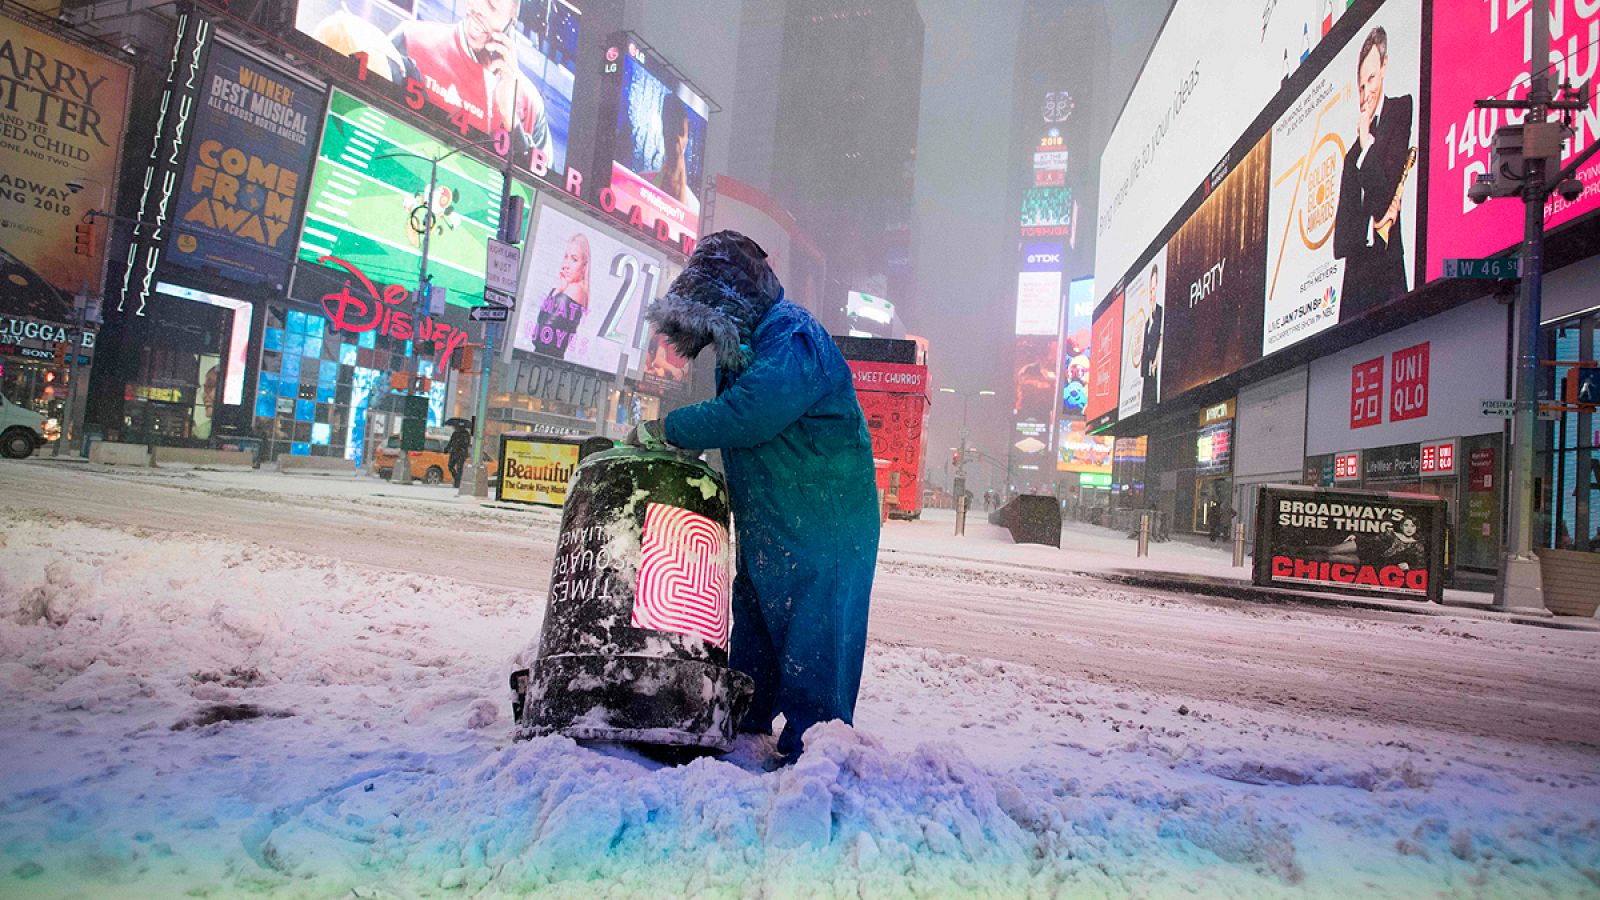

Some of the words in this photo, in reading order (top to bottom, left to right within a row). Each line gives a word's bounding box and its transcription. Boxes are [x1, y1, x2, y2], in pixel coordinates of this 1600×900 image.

[239, 66, 295, 108] WINNER!
[0, 74, 110, 147] TTER
[212, 75, 249, 107] BEST
[251, 92, 308, 136] MUSICAL
[1150, 107, 1172, 164] your
[1173, 59, 1200, 121] ideas
[27, 121, 48, 135] THE
[208, 95, 222, 110] ALL
[223, 102, 253, 123] ACROSS
[255, 115, 277, 133] NORTH
[277, 126, 306, 146] AMERICA
[1445, 95, 1498, 170] 140
[0, 141, 20, 153] ONE
[24, 148, 45, 160] AND
[47, 155, 69, 167] TWO
[33, 134, 90, 162] CHILD
[200, 139, 299, 198] COME
[1308, 152, 1337, 192] GOLDEN
[0, 174, 70, 201] ADWAY
[192, 164, 294, 224] FROM
[34, 196, 71, 216] 2018
[1307, 198, 1335, 233] AWARDS
[184, 197, 289, 247] AWAY
[1300, 278, 1314, 293] SETH
[1314, 264, 1338, 284] MEYERS
[1460, 261, 1474, 276] W
[1481, 260, 1501, 276] 46
[1507, 260, 1517, 271] St
[1189, 257, 1227, 309] PARTY
[597, 252, 662, 350] 21
[1322, 304, 1336, 318] NBC
[0, 316, 97, 348] LUGGAE
[1267, 317, 1281, 333] LIVE
[22, 347, 55, 359] SONY
[1395, 352, 1422, 383] UNI
[514, 361, 602, 408] FOREVER
[858, 370, 883, 382] SWEET
[884, 372, 921, 385] CHURROS
[1356, 366, 1379, 393] ユニ
[1354, 395, 1378, 421] クロ
[1394, 384, 1425, 416] QLO
[507, 458, 575, 483] Beautiful
[1394, 456, 1420, 472] Pop-Up
[505, 480, 516, 489] The
[536, 483, 550, 495] King
[1279, 500, 1405, 521] BROADWAY'S
[1279, 513, 1329, 529] SURE
[1333, 517, 1394, 534] THING
[1271, 555, 1428, 592] CHICAGO
[551, 578, 613, 605] TIMES
